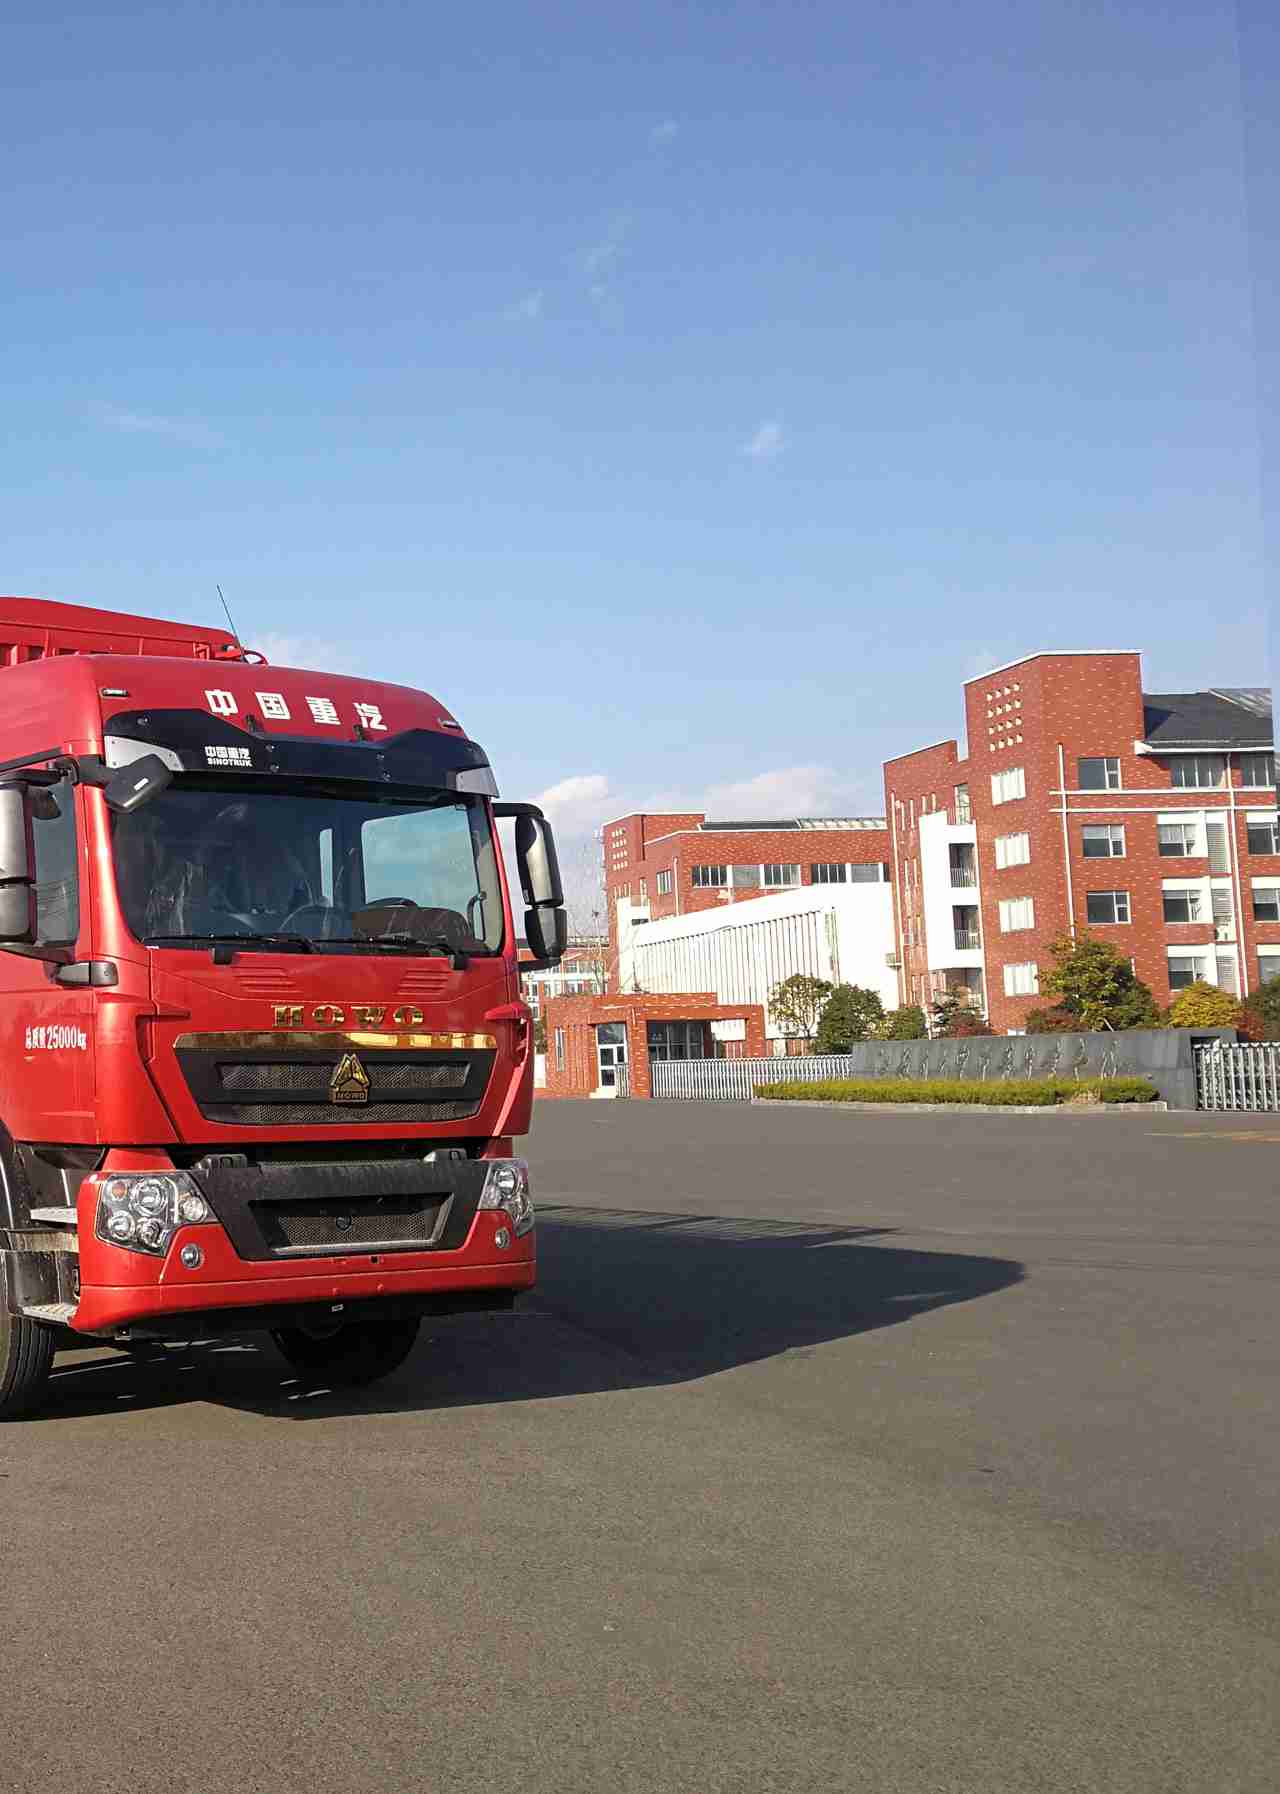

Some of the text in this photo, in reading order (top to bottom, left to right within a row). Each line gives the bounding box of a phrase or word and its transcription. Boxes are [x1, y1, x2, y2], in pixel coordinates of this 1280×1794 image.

[204, 690, 387, 730] 中国重汽
[205, 746, 251, 759] 中国重汽
[207, 757, 252, 767] SINOTRUK
[271, 1004, 424, 1029] HOWO
